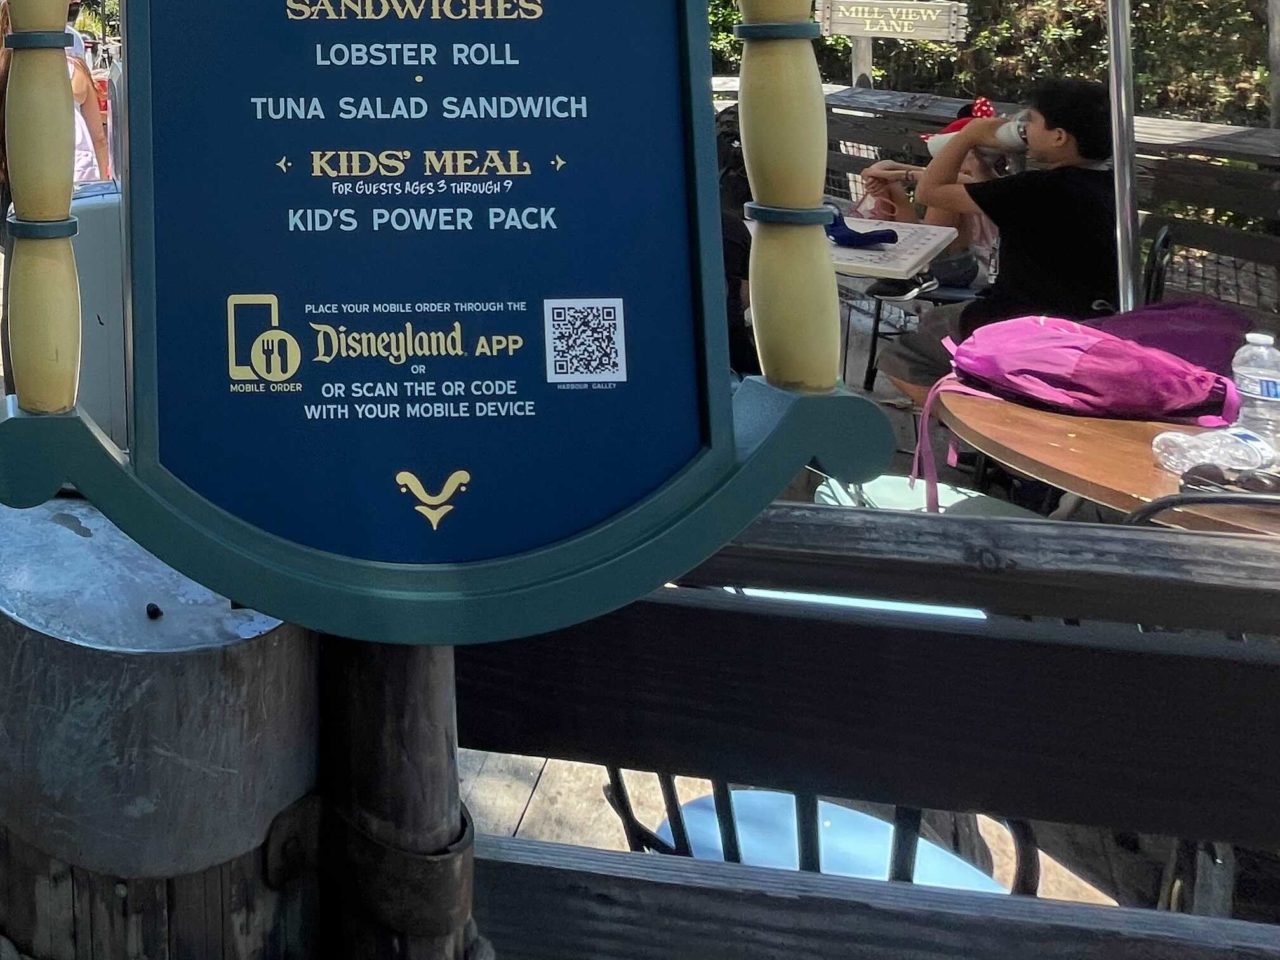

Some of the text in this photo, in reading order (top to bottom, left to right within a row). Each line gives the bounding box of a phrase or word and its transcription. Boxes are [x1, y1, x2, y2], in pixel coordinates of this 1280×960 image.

[838, 5, 942, 21] MILL VIEW
[863, 20, 917, 33] LANE
[316, 43, 520, 66] LOBSTER ROLL
[251, 96, 588, 120] TUNA SALAD SANDWICH
[310, 150, 532, 177] KIDS' MEAL
[332, 180, 513, 195] FOR GUESTS AGES 3 THROUGH 9
[288, 207, 558, 231] KID'S POWER PACK
[305, 301, 527, 314] PLACE YOUR MOBILE ORDER THROUGH THE
[308, 321, 524, 365] Disneyland APP
[410, 364, 426, 374] OR
[230, 382, 303, 393] MOBILE ORDER
[321, 380, 517, 398] OR SCAN THE QR CODE
[304, 401, 536, 420] WITH YOUR MOBILE DEVICE
